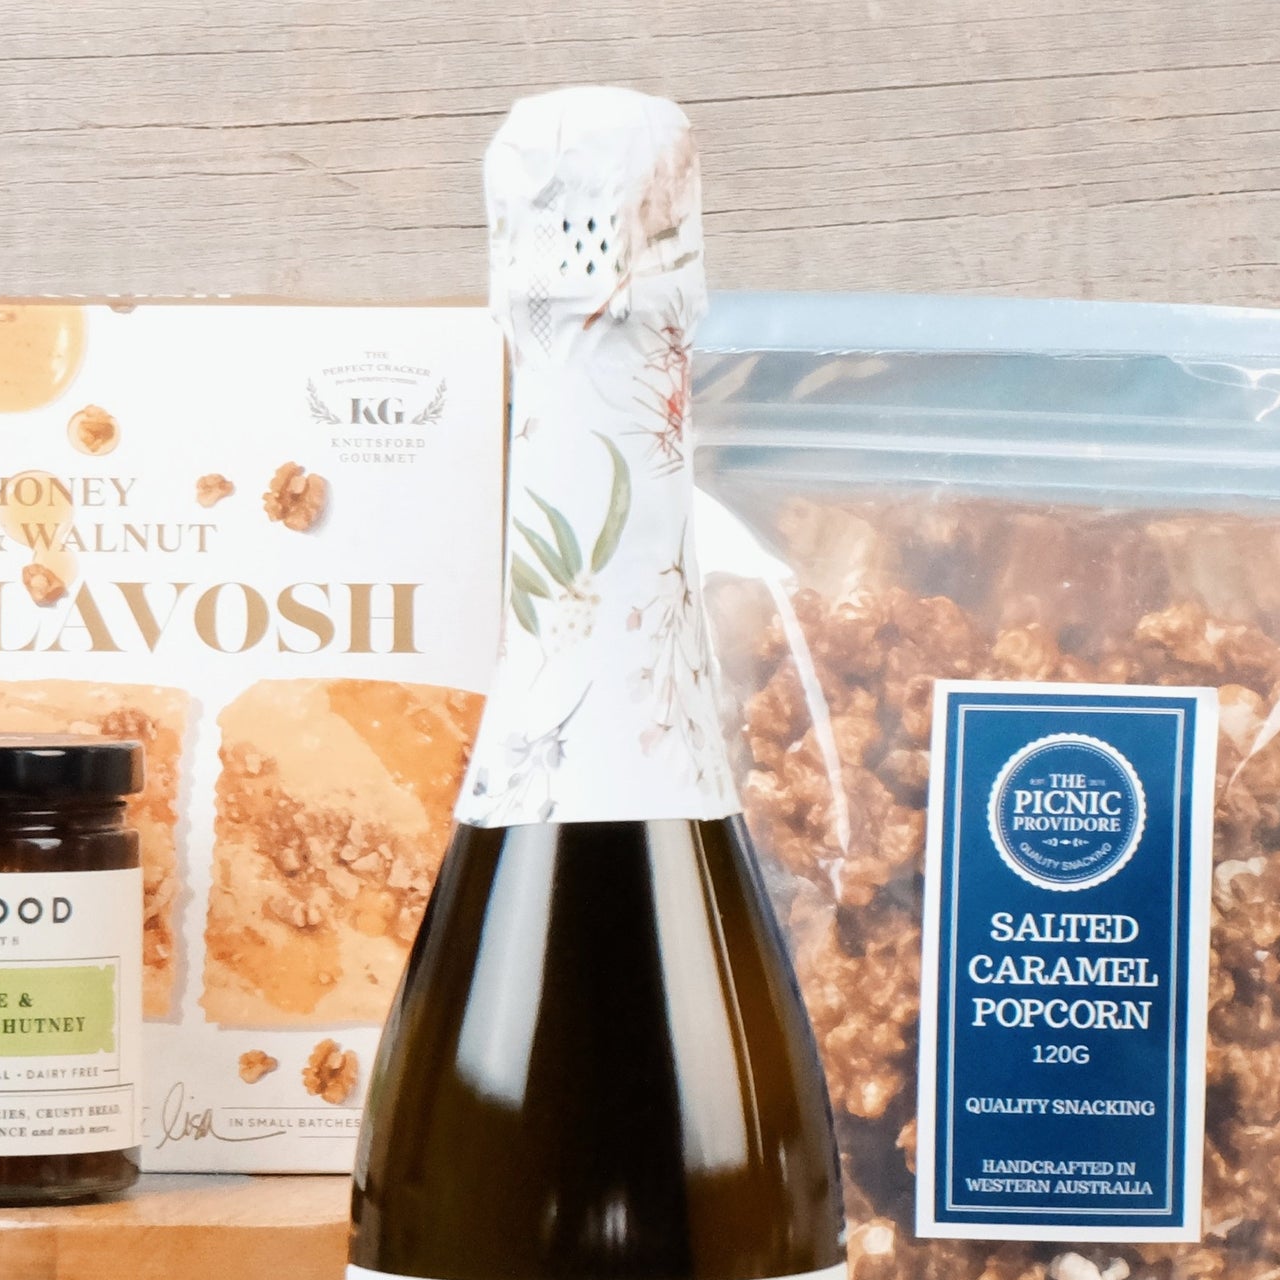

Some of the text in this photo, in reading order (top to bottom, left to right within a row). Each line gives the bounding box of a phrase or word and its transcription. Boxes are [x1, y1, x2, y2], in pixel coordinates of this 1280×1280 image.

[322, 363, 431, 377] PERFECT CRACKER
[350, 397, 405, 425] KG
[331, 438, 425, 448] KNUTSFORD
[340, 453, 416, 464] GOURMET
[19, 523, 218, 553] WALNUT
[1049, 773, 1086, 788] THE
[1013, 790, 1122, 815] PICNIC
[1013, 816, 1121, 832] PROVIDORE
[1020, 842, 1112, 871] QUALITY SNACKING
[990, 912, 1139, 944] SALTED
[968, 955, 1158, 988] CARAMEL
[18, 992, 34, 1008] &
[971, 998, 1152, 1030] POPCORN
[1033, 1044, 1090, 1065] 120G
[26, 1069, 67, 1080] DAIRY
[72, 1066, 99, 1078] FREE
[36, 1106, 84, 1119] CRUSTY
[965, 1097, 1155, 1117] QUALITY SNACKING
[31, 1126, 54, 1137] and
[229, 1118, 361, 1128] IN SMALL BATCHES
[982, 1159, 1136, 1177] HANDCRAFTED IN
[965, 1177, 1153, 1196] WESTERN AUSTRALIA
